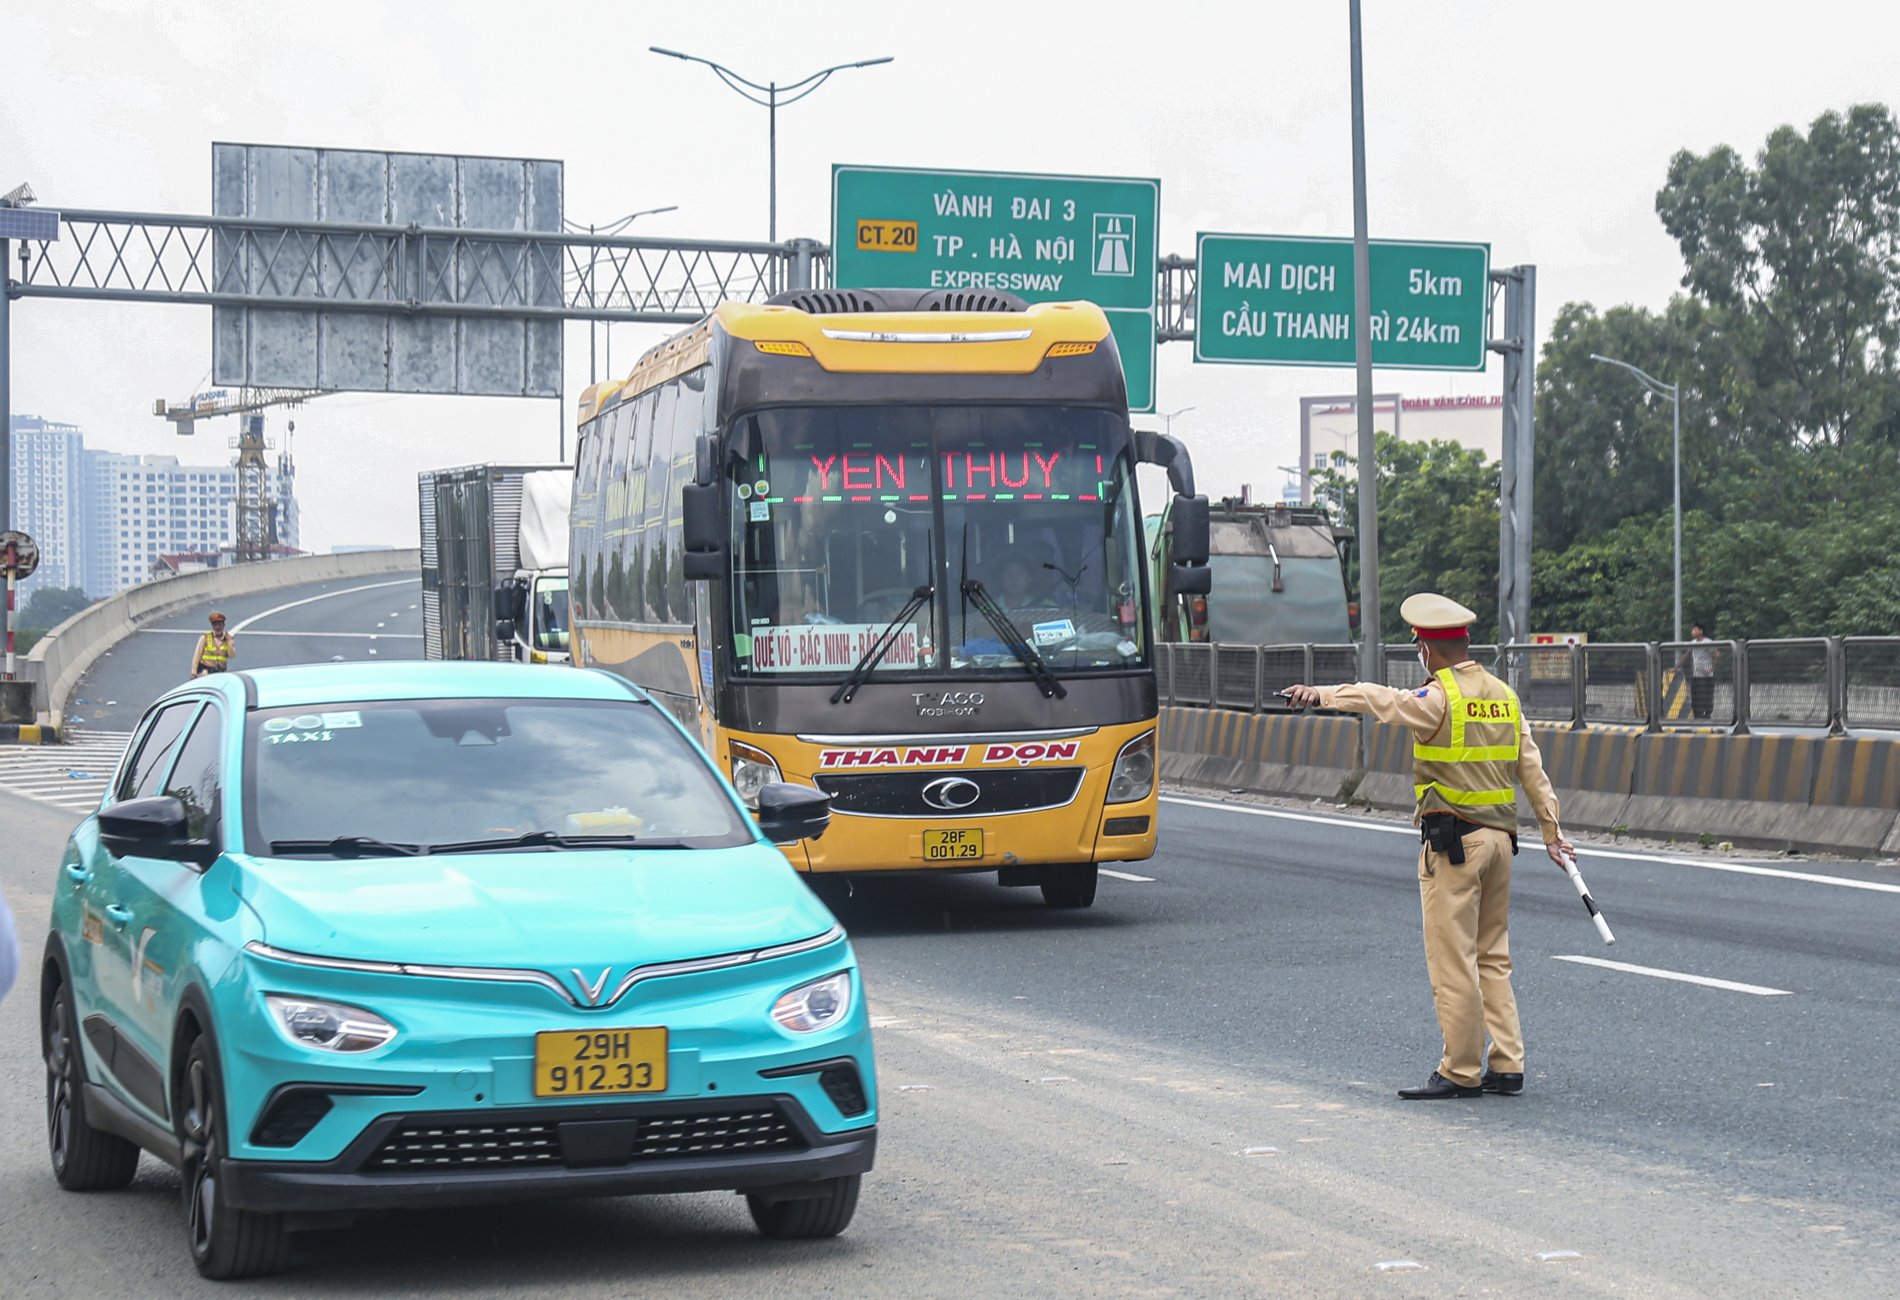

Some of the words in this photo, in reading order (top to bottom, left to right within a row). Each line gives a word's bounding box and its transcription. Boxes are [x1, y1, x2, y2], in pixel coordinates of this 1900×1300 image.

[933, 189, 993, 218] VÀNH
[1010, 196, 1051, 221] ĐAI
[1062, 199, 1077, 222] 3
[858, 225, 916, 247] CT.20
[989, 233, 1023, 260] HÀ
[1034, 236, 1075, 264] NỘI
[930, 269, 1064, 292] EXPRESSWAY
[1223, 262, 1272, 290] MAI
[1280, 263, 1336, 295] DỊCH
[1408, 268, 1463, 297] 5km
[1222, 300, 1267, 337] CẦU
[1273, 311, 1350, 341] THANH
[1369, 309, 1390, 342] RÌ
[1395, 316, 1461, 344] 24km
[811, 451, 905, 489] YEN
[940, 450, 1061, 489] THUY
[753, 628, 775, 672] QUẾ
[777, 629, 792, 667] VÕ
[800, 626, 821, 666] BẮC
[824, 632, 851, 665] NINH
[883, 631, 916, 665] GIANG
[267, 730, 333, 745] TAXI
[820, 745, 969, 768] THANH
[983, 741, 1081, 766] DỌN
[930, 844, 977, 858] 001.29
[940, 831, 966, 844] 28F
[574, 1033, 631, 1061] 29H
[550, 1062, 653, 1092] 912.33
